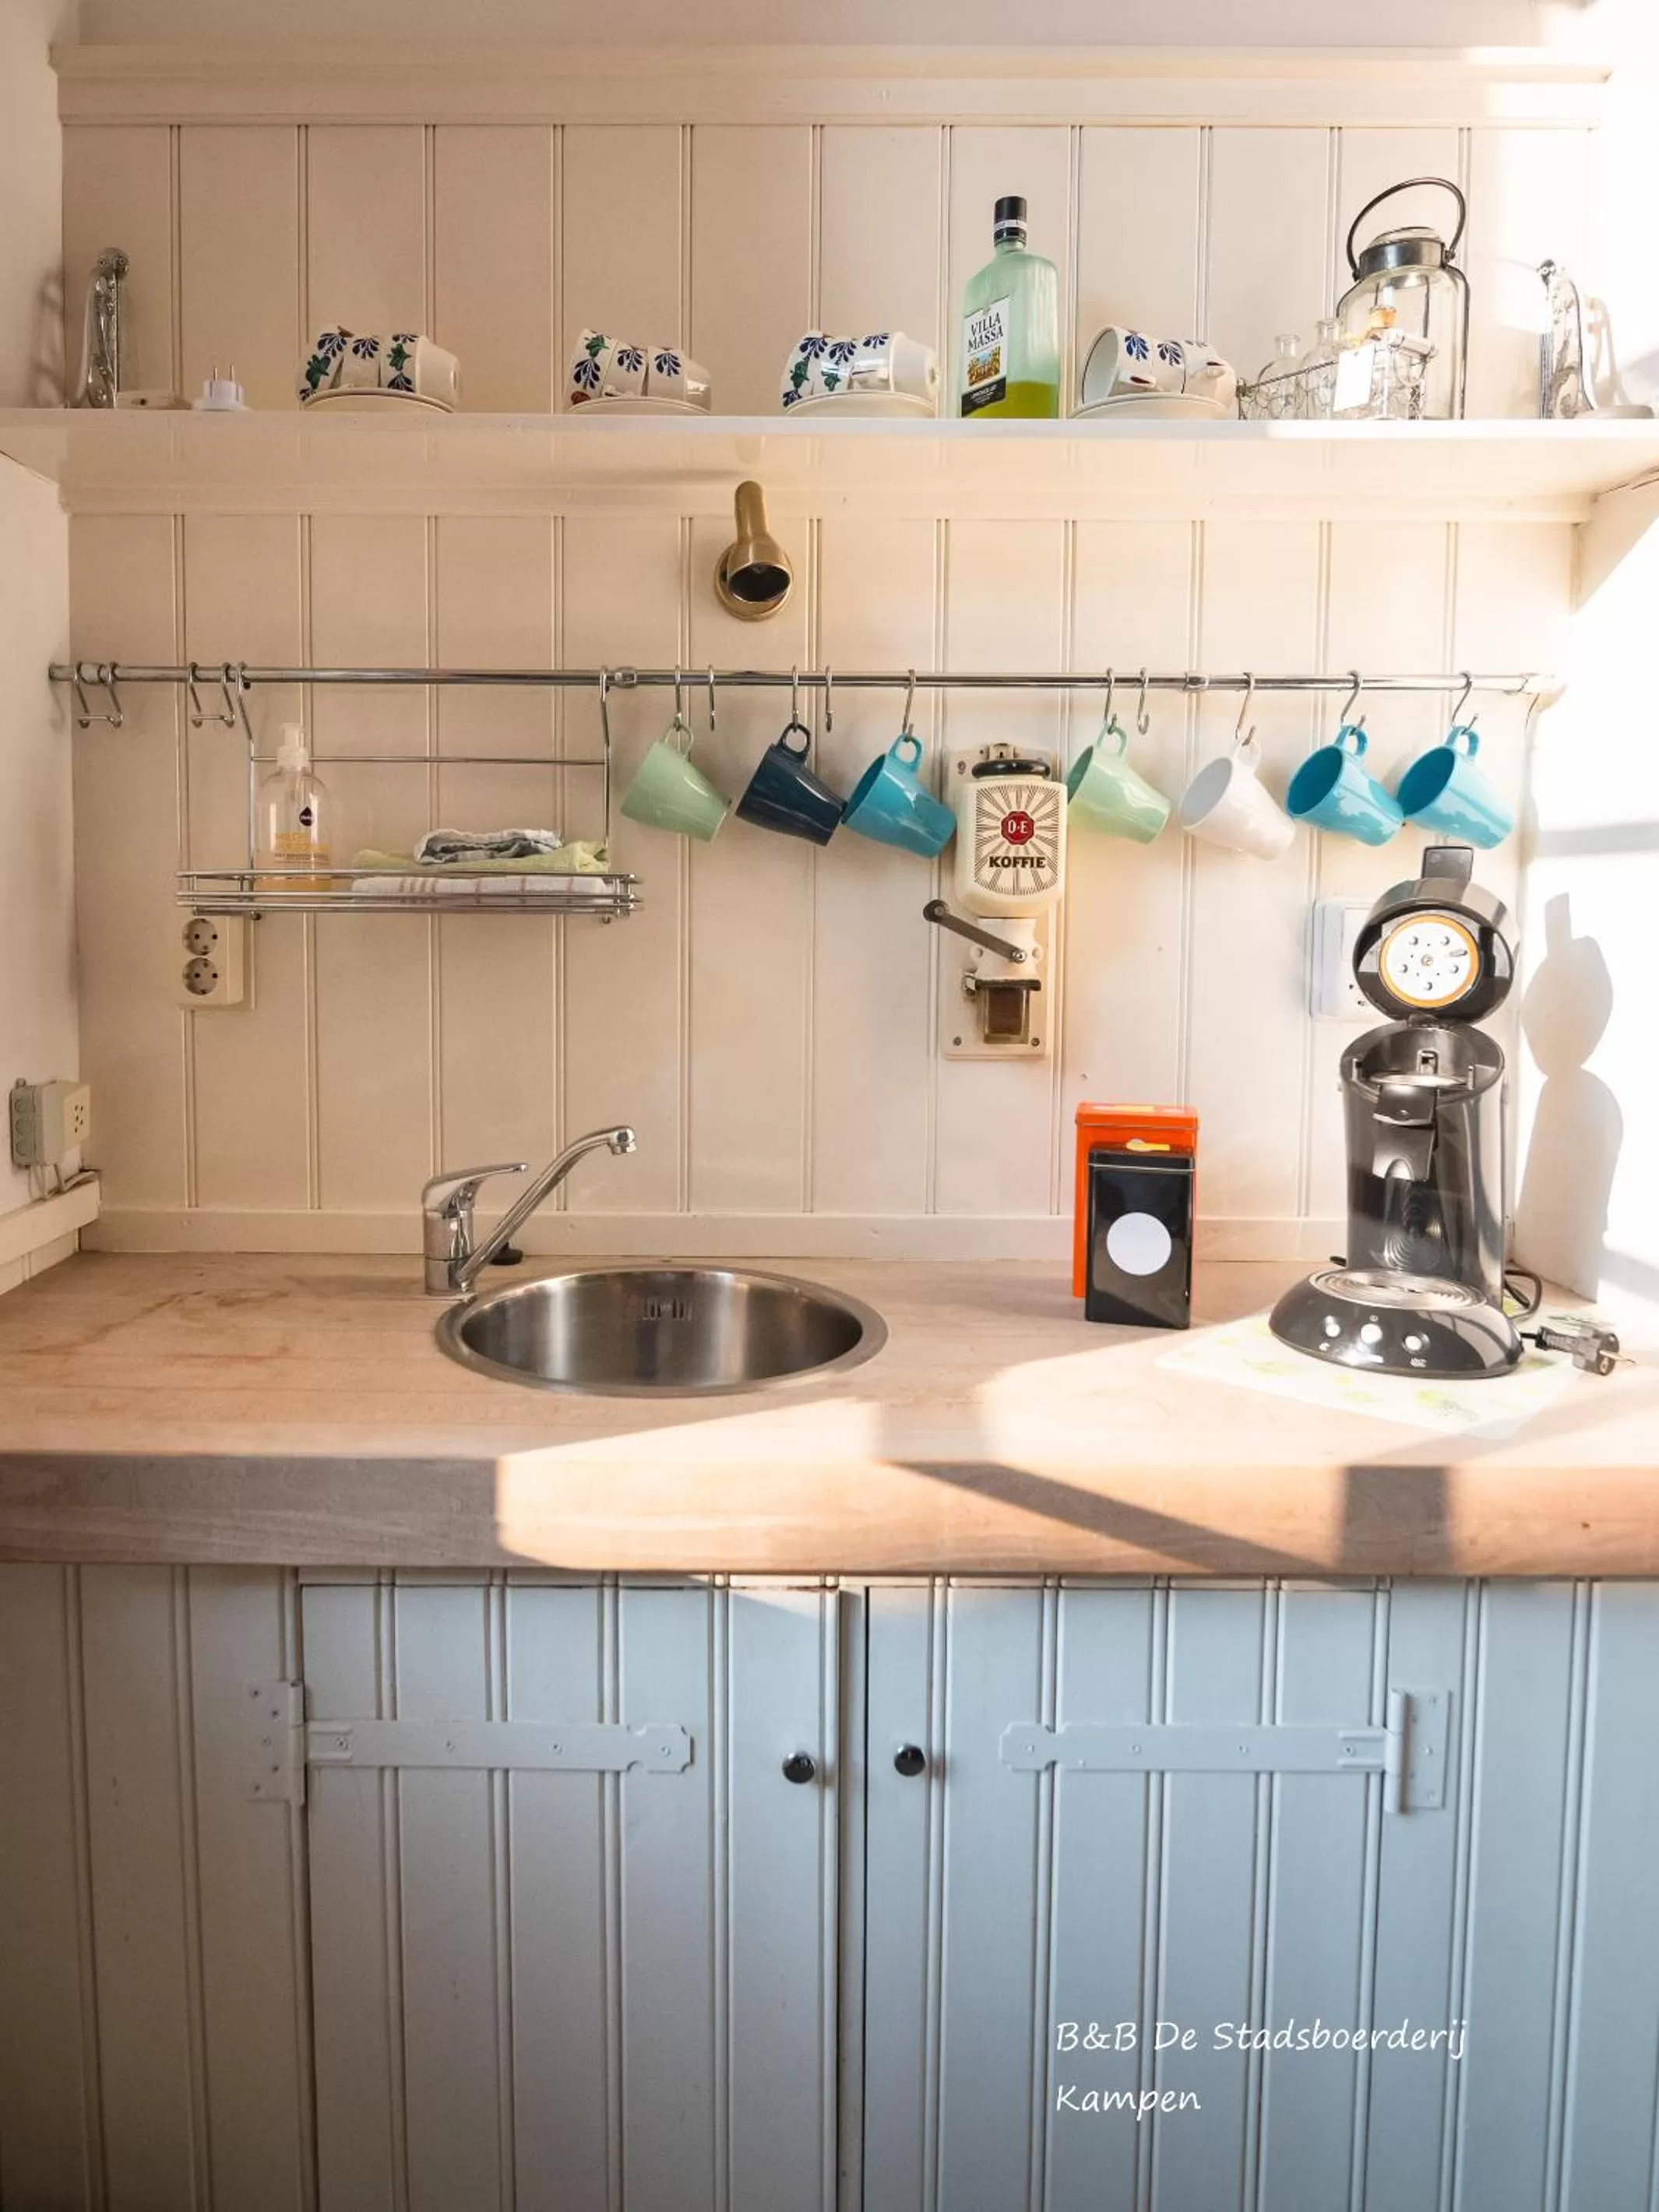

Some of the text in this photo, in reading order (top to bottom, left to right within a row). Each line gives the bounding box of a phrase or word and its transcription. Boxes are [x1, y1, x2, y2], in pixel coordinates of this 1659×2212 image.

[971, 312, 1001, 336] VILLA
[967, 325, 1003, 353] MASSA
[989, 856, 1046, 868] KOFFIE
